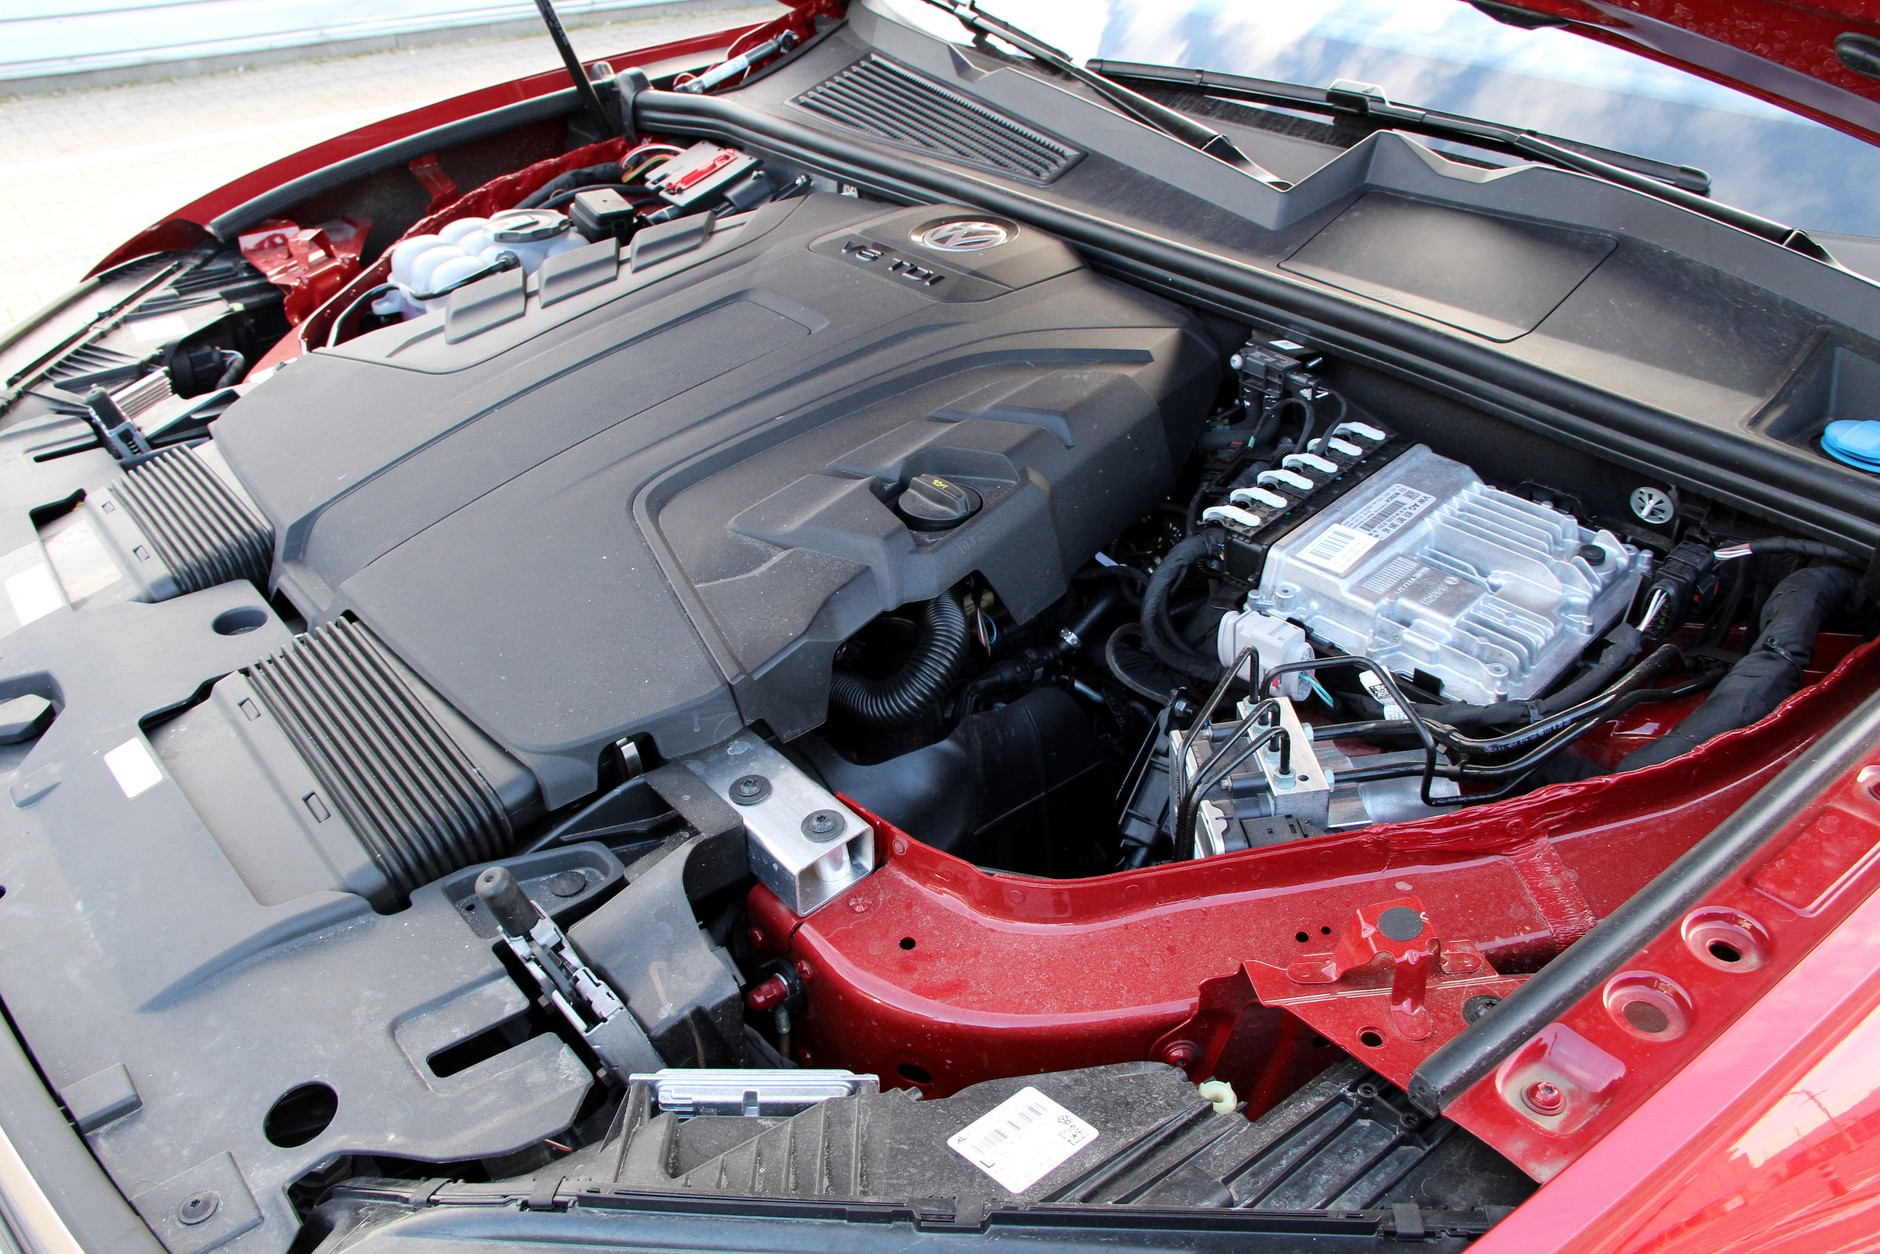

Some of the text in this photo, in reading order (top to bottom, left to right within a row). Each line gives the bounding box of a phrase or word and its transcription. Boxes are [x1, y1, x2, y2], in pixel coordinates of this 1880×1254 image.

[841, 240, 945, 286] V6 TDI
[1385, 492, 1400, 503] BOSCH
[1416, 495, 1430, 505] VW
[1408, 503, 1420, 511] AG
